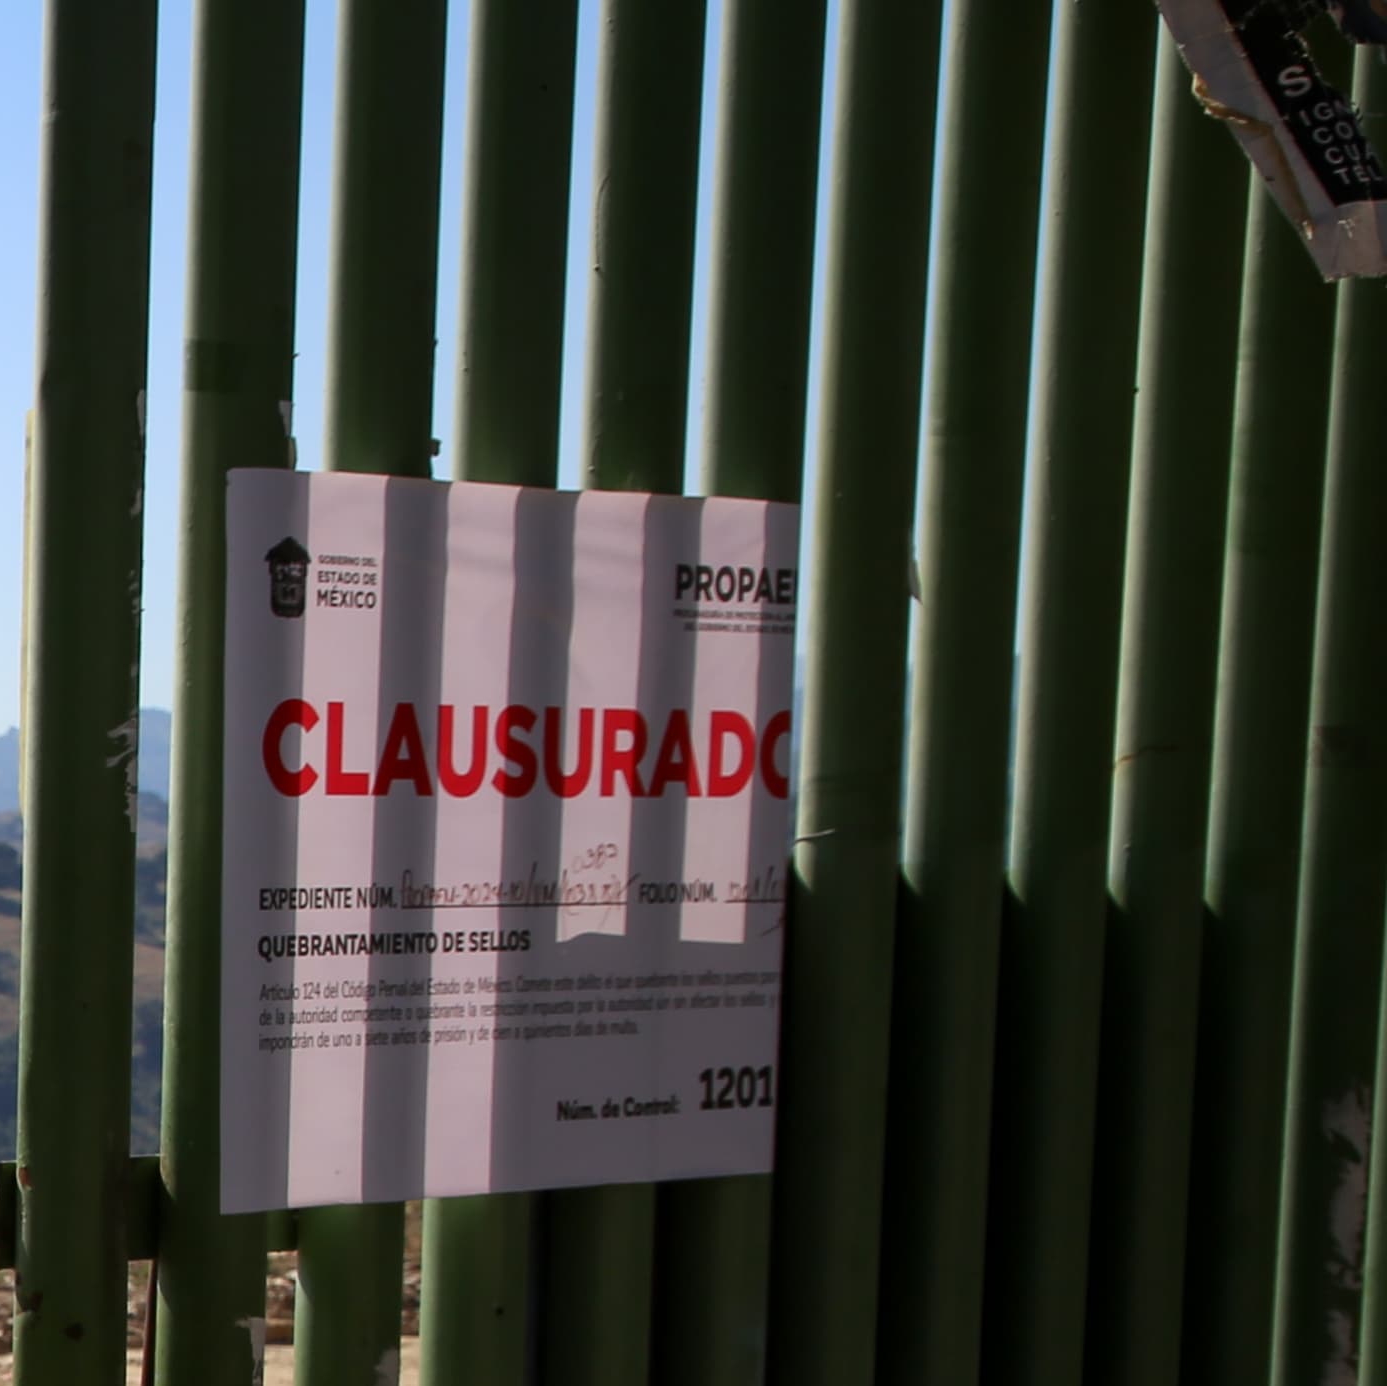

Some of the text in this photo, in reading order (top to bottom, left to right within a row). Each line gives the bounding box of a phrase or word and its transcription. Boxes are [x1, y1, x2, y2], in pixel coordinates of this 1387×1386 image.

[317, 570, 378, 586] ESTADO DE
[316, 585, 377, 609] MÉXICO
[259, 887, 352, 911] EXPEDIENTE
[356, 882, 397, 909] NÚM.
[680, 878, 718, 903] NÚM.
[258, 929, 531, 963] QUEBRANTAMIENTO DE SELLOS
[259, 981, 300, 1001] Artículo
[303, 981, 321, 1000] 124
[322, 981, 339, 999] del
[259, 1008, 272, 1026] de
[276, 1007, 285, 1025] la
[289, 1006, 337, 1025] autoridad
[259, 1030, 314, 1054] impondrán
[317, 1031, 331, 1048] de
[333, 1033, 352, 1048] uno
[354, 1034, 362, 1047] a
[556, 1064, 773, 1121] Núm. de Control: 1201
